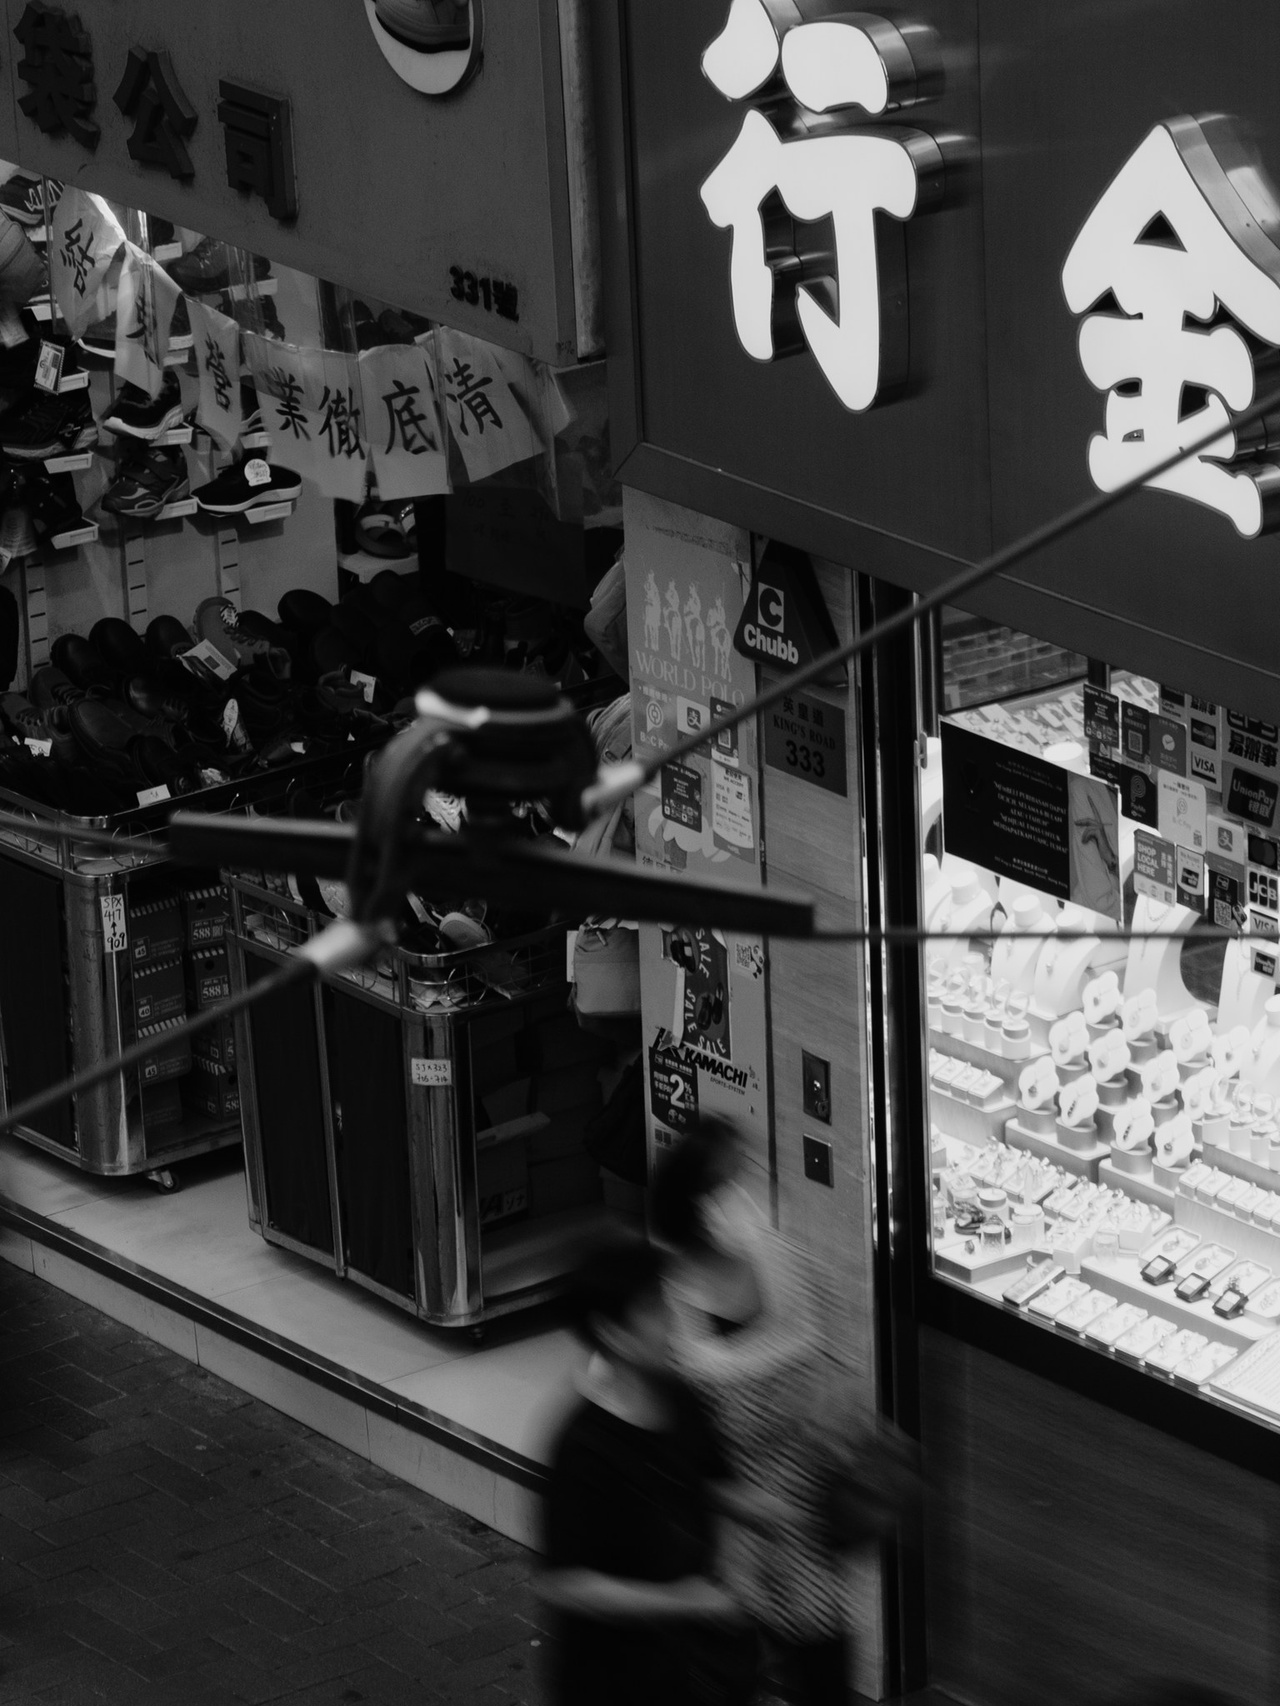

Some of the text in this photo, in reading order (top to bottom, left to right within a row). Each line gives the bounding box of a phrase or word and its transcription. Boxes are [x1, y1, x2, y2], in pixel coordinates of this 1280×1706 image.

[744, 624, 799, 664] Chubb
[636, 650, 696, 691] WORLD
[783, 696, 824, 727] 英皇道
[773, 714, 836, 749] KING'S ROAD
[1228, 730, 1278, 767] 易辦事
[785, 740, 825, 778] 333
[1194, 756, 1216, 775] VISA
[1232, 778, 1275, 809] UnionPay
[1248, 799, 1271, 819] 銀聯
[1138, 842, 1157, 857] SHOP
[1137, 853, 1159, 869] LOCAL
[1137, 862, 1155, 877] HERE
[1250, 882, 1277, 901] JCB
[103, 897, 122, 909] SPX
[104, 909, 121, 922] 417
[1254, 917, 1275, 932] VISA
[107, 932, 125, 951] 909
[193, 926, 211, 941] 588
[696, 928, 711, 979] SALE
[202, 985, 221, 999] 588
[685, 989, 697, 1033] SALE
[698, 1035, 726, 1057] SALE
[685, 1047, 748, 1088] KAMACHI
